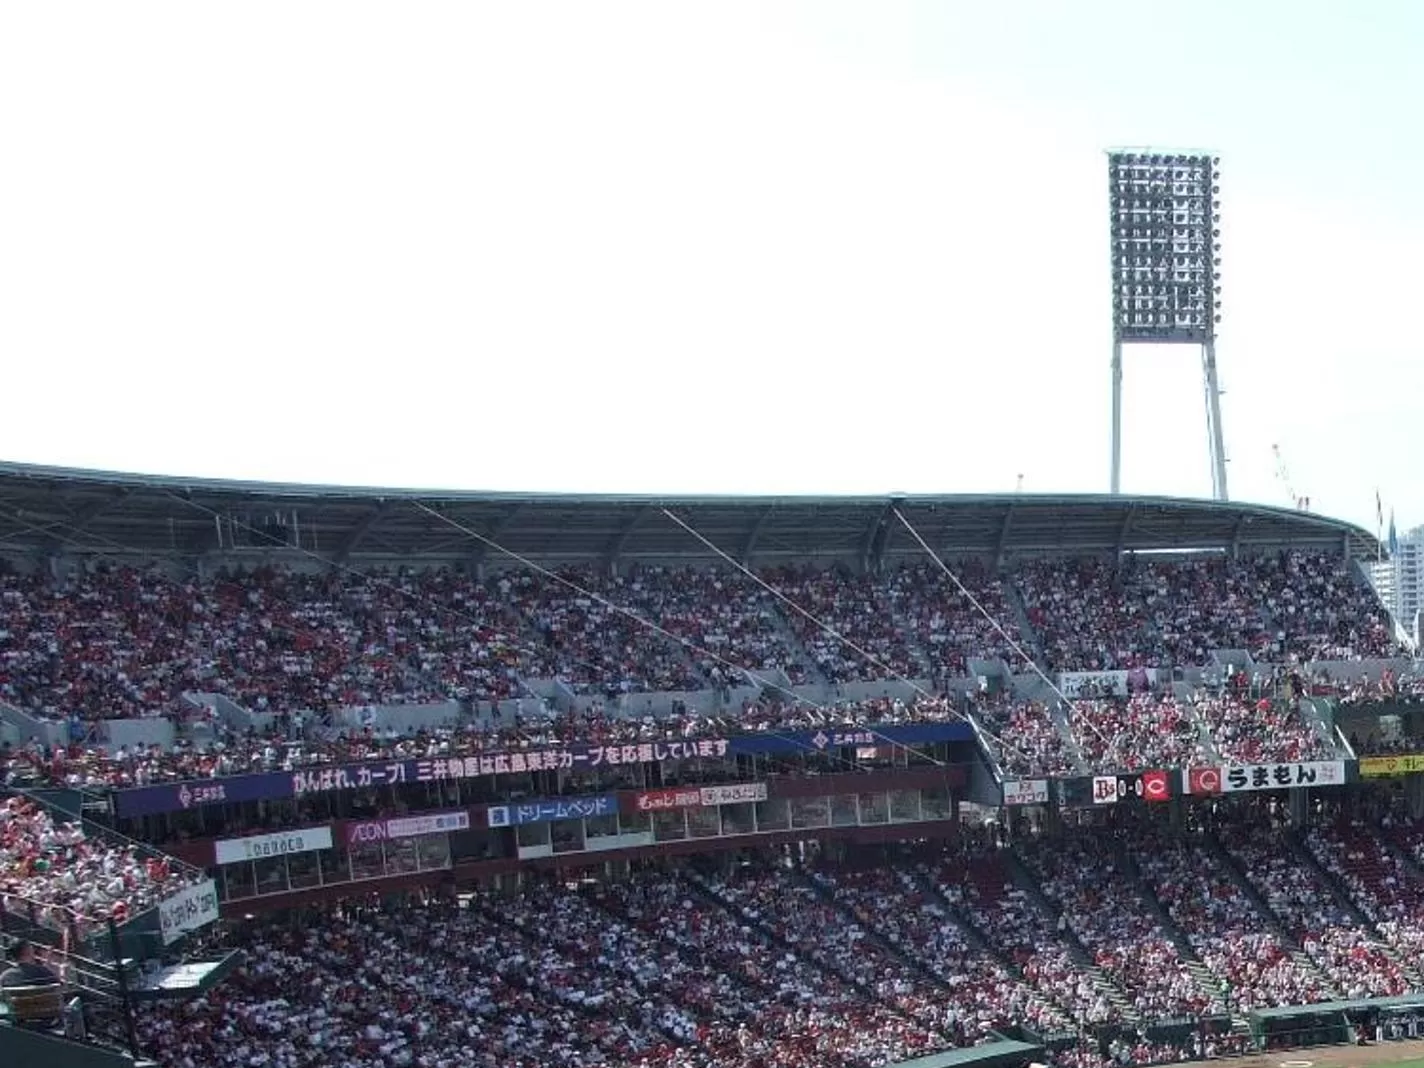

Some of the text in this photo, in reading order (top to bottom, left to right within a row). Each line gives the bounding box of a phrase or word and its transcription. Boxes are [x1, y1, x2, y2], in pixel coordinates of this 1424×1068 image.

[1228, 764, 1317, 788] うまもん
[517, 798, 608, 823] ドリームベッド
